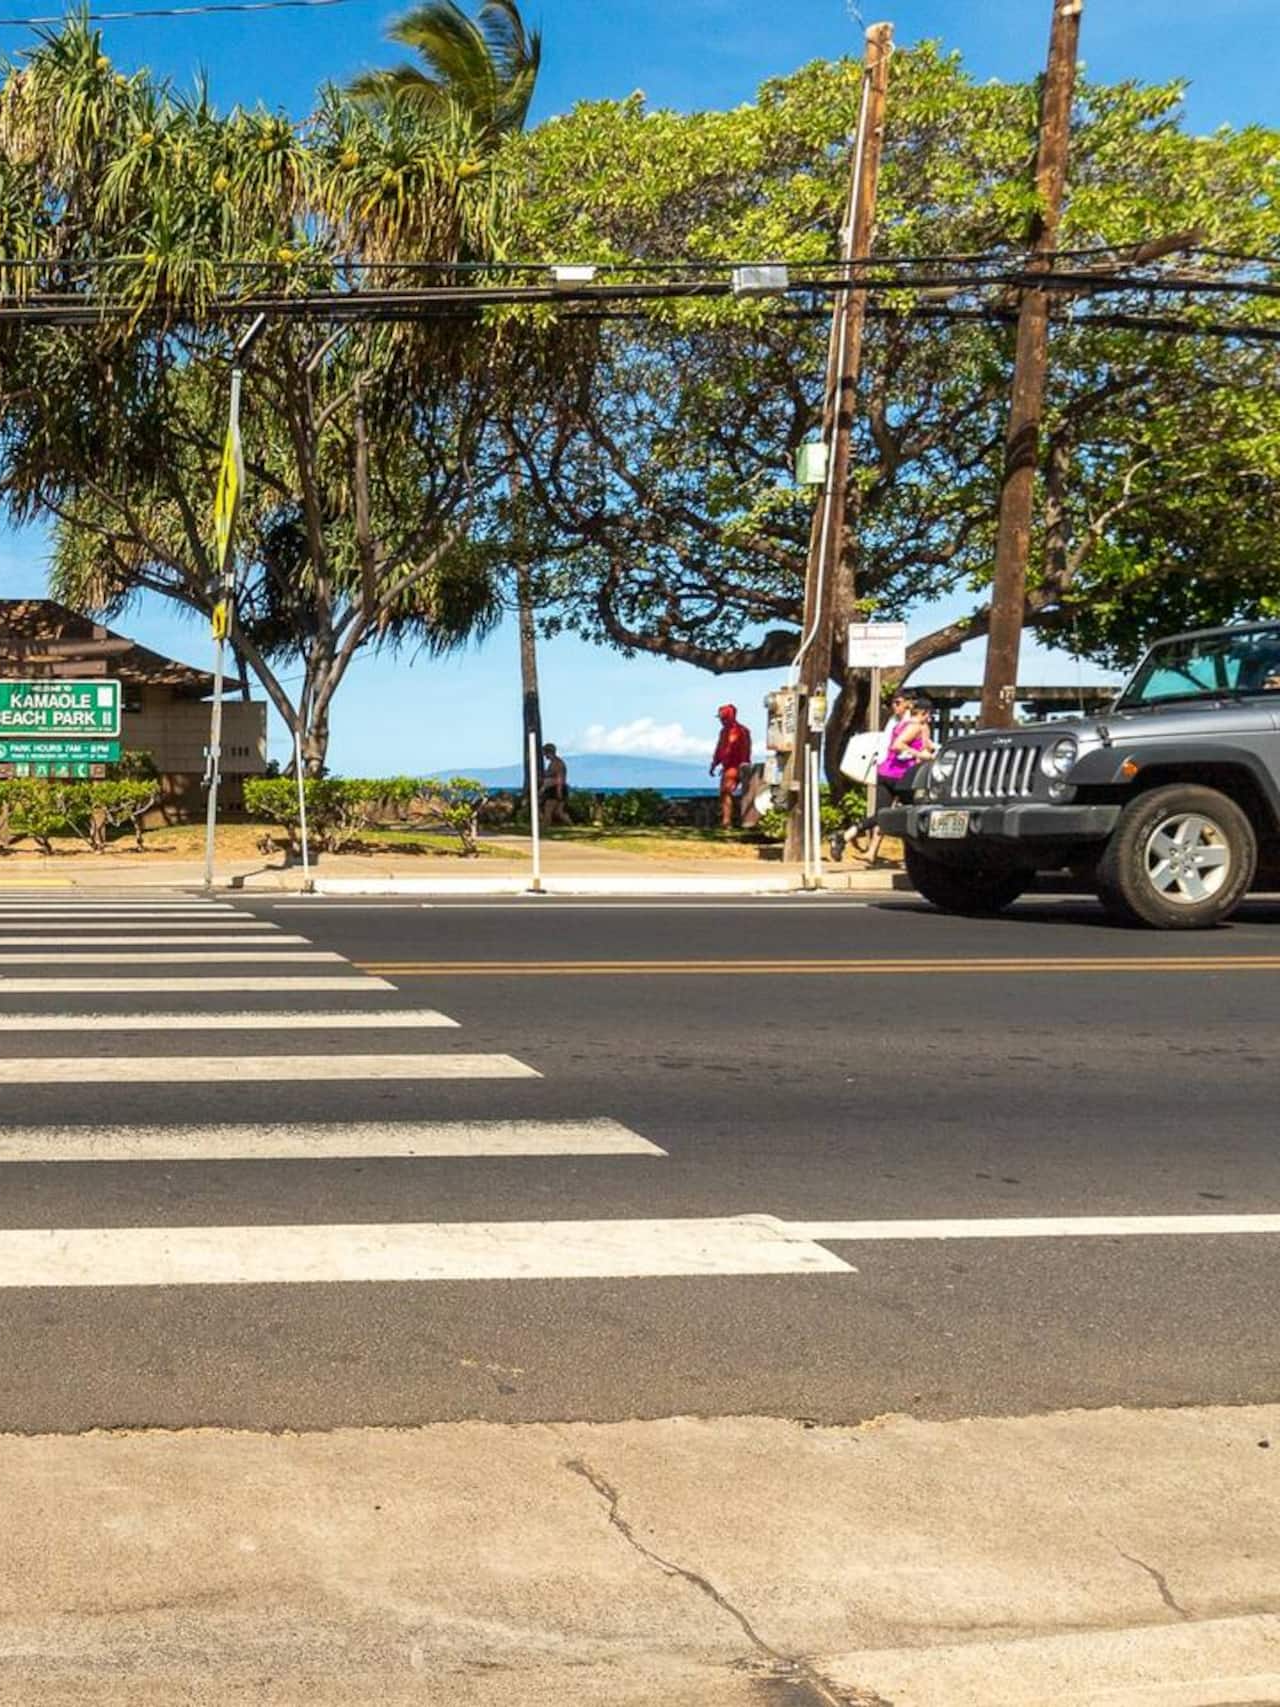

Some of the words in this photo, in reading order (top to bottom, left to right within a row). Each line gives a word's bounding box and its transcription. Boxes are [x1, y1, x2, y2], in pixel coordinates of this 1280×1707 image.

[10, 693, 91, 708] KAMAOLE
[52, 710, 96, 725] PARK
[10, 744, 31, 753] PARK
[33, 744, 62, 753] HOURS
